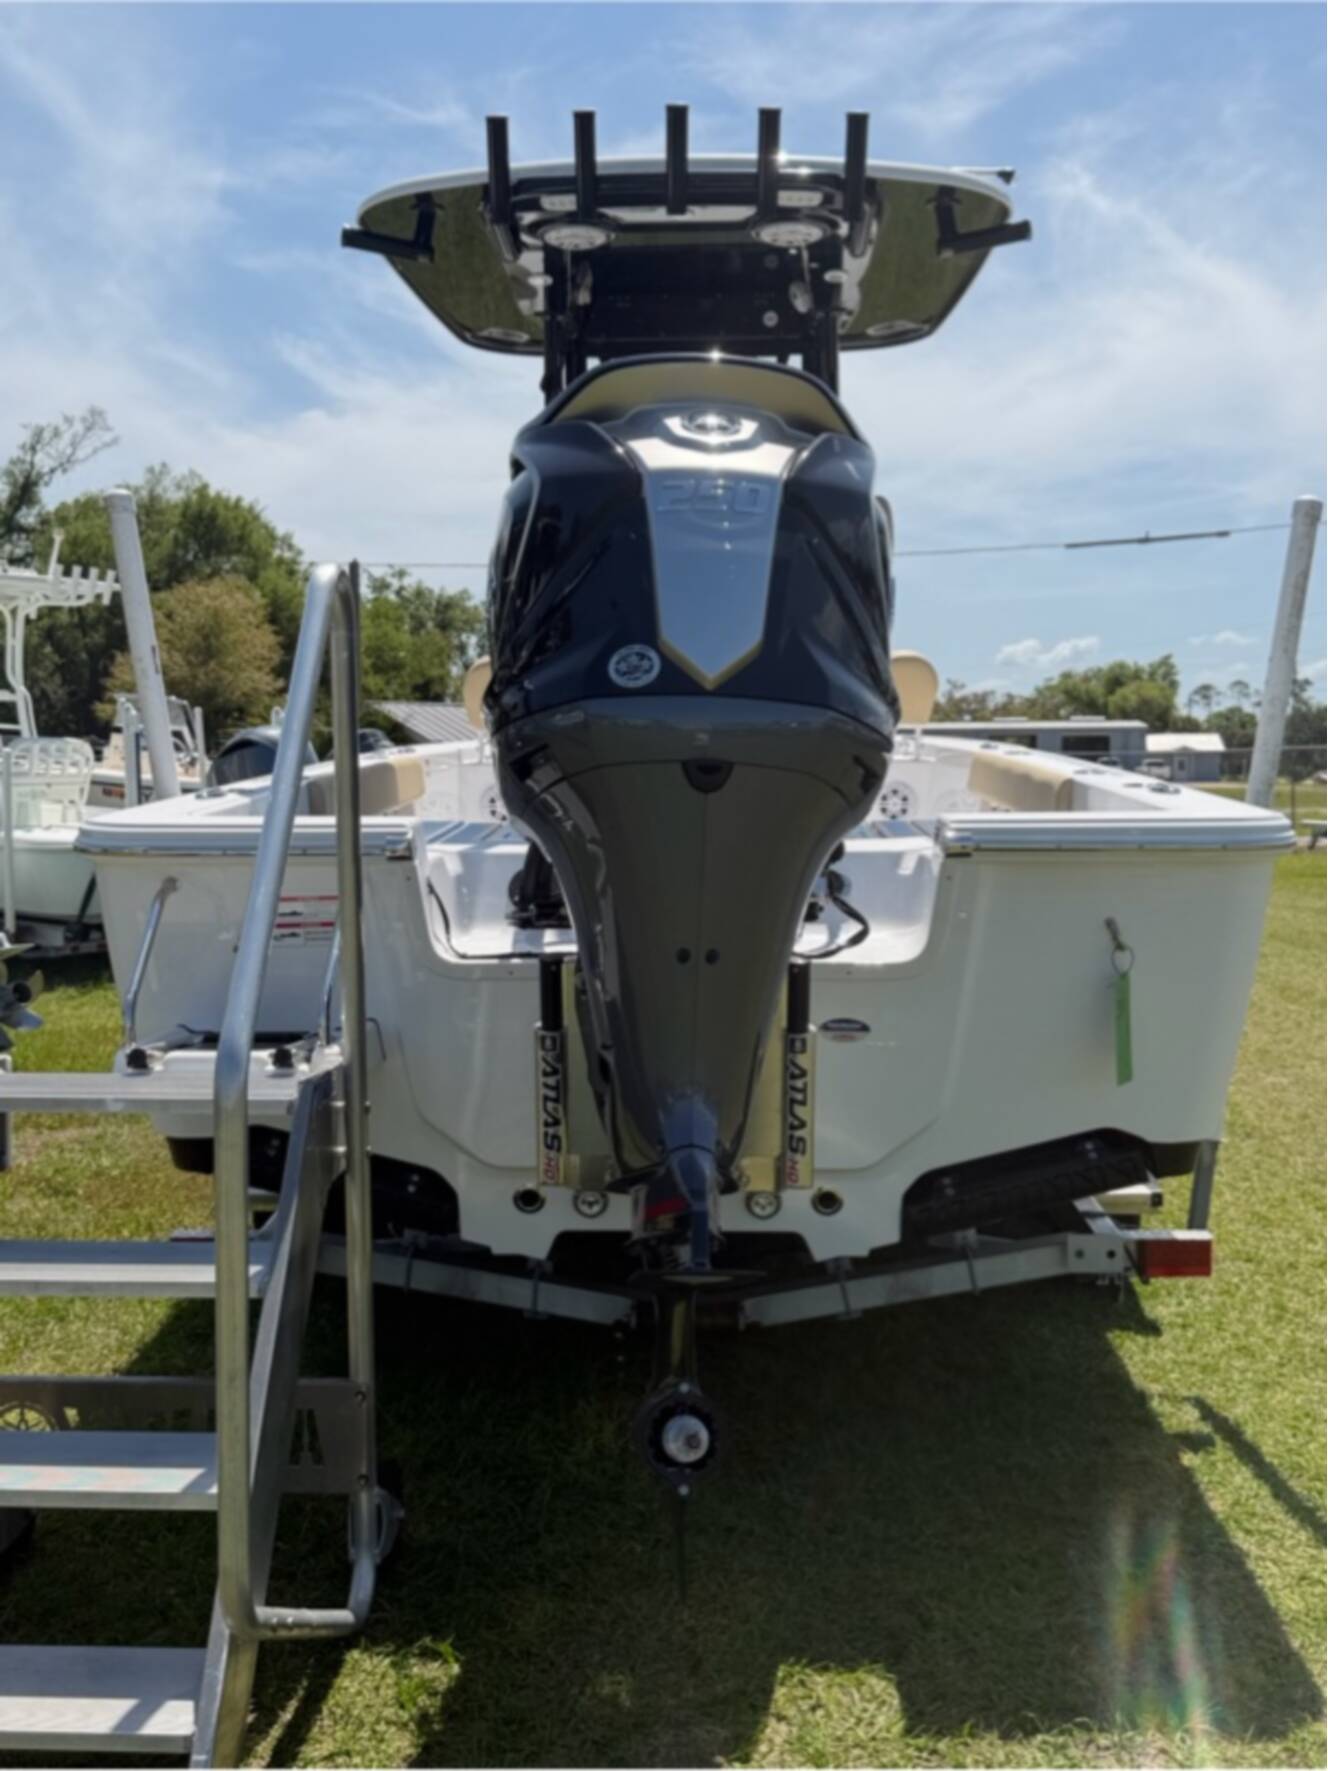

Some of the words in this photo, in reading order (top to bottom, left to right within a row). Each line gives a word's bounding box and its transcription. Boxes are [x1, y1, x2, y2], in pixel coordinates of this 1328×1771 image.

[658, 480, 768, 513] 250
[542, 1054, 562, 1153] ATLAS
[788, 1060, 808, 1157] ATLAS
